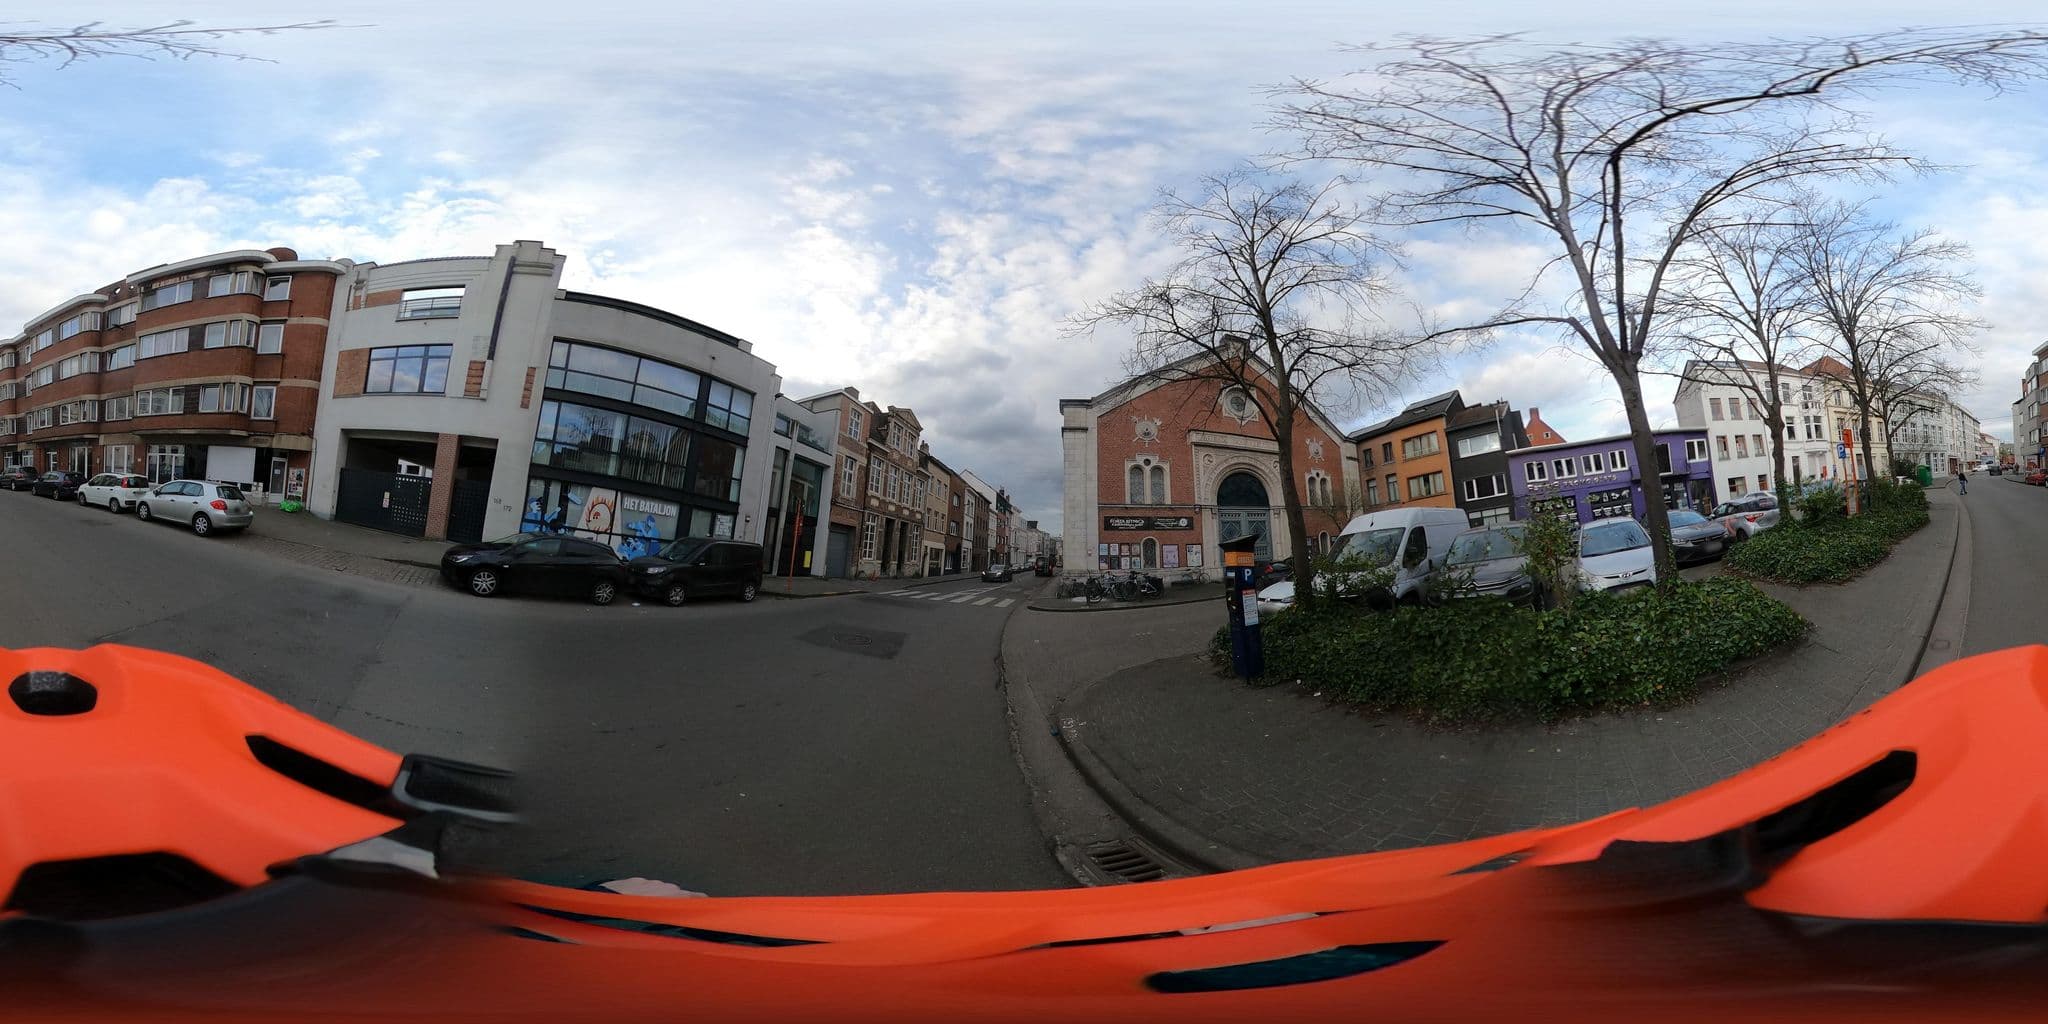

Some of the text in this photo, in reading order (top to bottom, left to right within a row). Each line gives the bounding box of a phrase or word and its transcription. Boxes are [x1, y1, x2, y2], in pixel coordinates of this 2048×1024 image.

[1837, 445, 1844, 458] P
[624, 496, 677, 517] HET BATALJON
[1244, 568, 1252, 581] P
